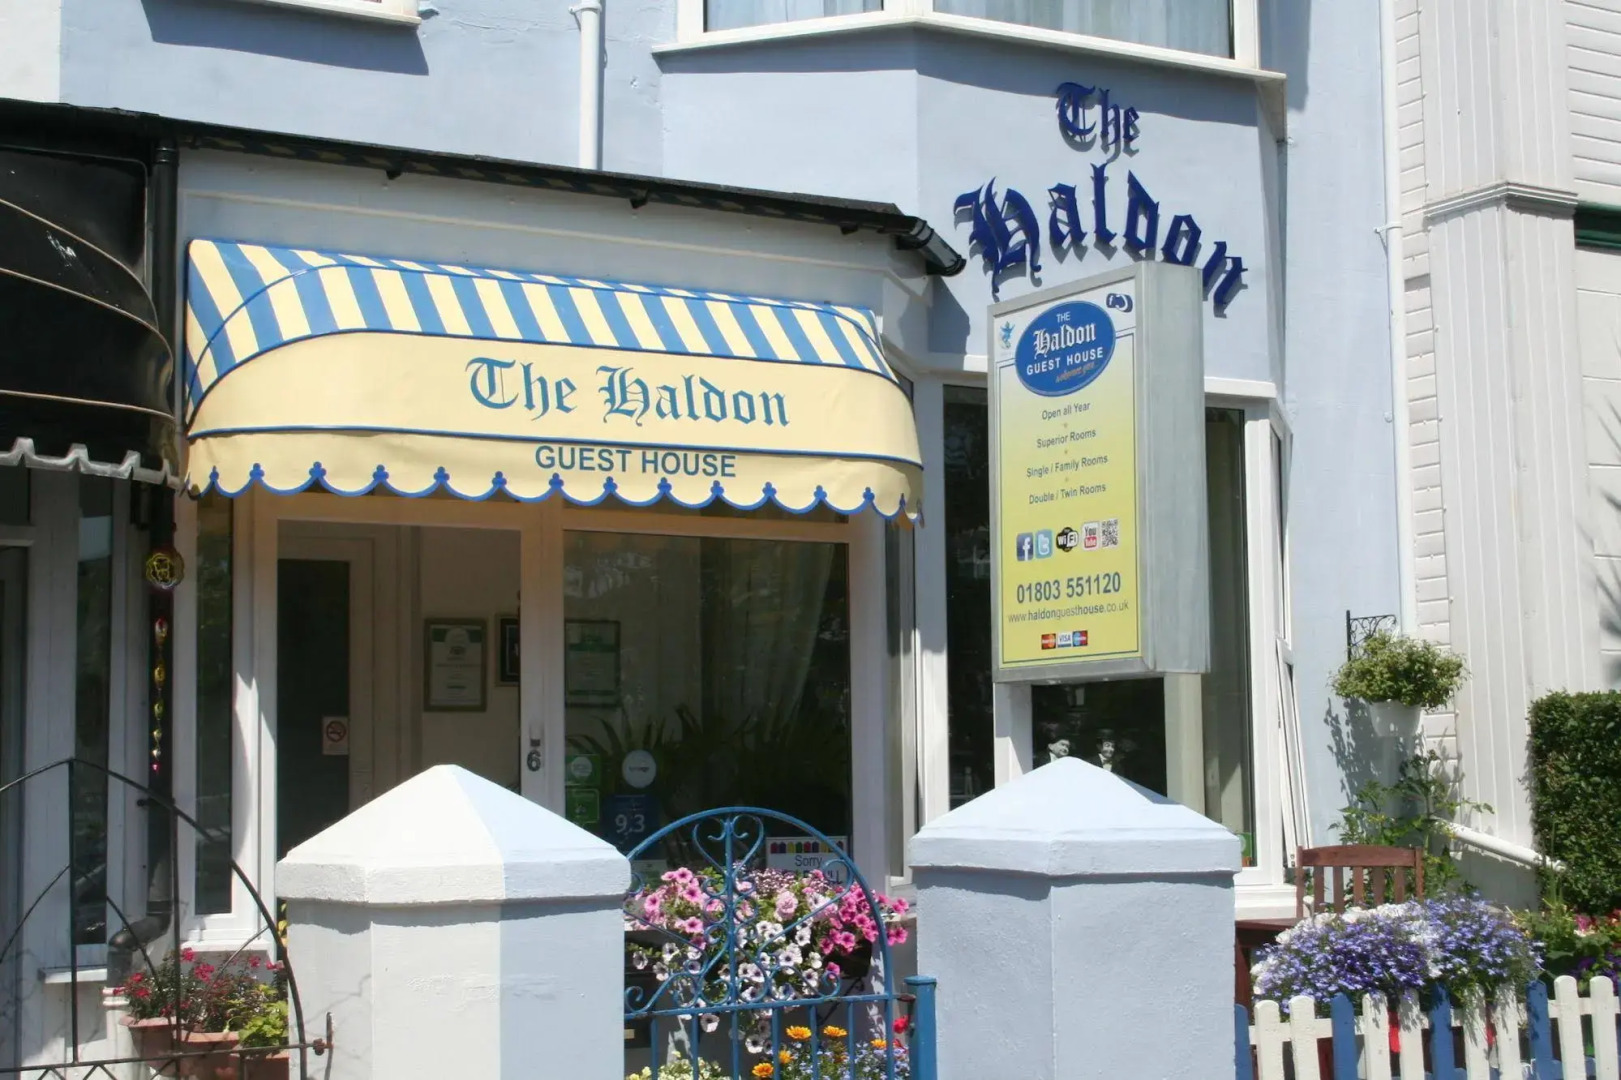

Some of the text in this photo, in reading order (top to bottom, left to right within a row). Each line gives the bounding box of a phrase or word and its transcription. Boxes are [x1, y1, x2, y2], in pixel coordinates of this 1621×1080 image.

[1055, 82, 1140, 146] The
[953, 162, 1248, 307] Haldon
[1056, 311, 1071, 323] THE
[1033, 322, 1096, 360] Haldon
[1026, 347, 1104, 376] GUEST HOUSE
[465, 356, 790, 428] The Haldon
[1042, 402, 1091, 421] Open all Year
[1036, 428, 1097, 449] Superior Rooms
[534, 444, 737, 478] GUEST HOUSE
[1026, 464, 1050, 479] Single
[1055, 459, 1079, 474] Family
[1081, 454, 1109, 467] Rooms
[1029, 492, 1055, 505] Double
[1060, 488, 1078, 499] Twin
[1079, 483, 1107, 496] Rooms
[1084, 527, 1097, 537] You
[1016, 572, 1121, 604] 01803 551120
[1008, 599, 1130, 624] www.haldonguesthouse.co.uk
[526, 750, 542, 772] 6
[794, 854, 823, 869] Sorry
